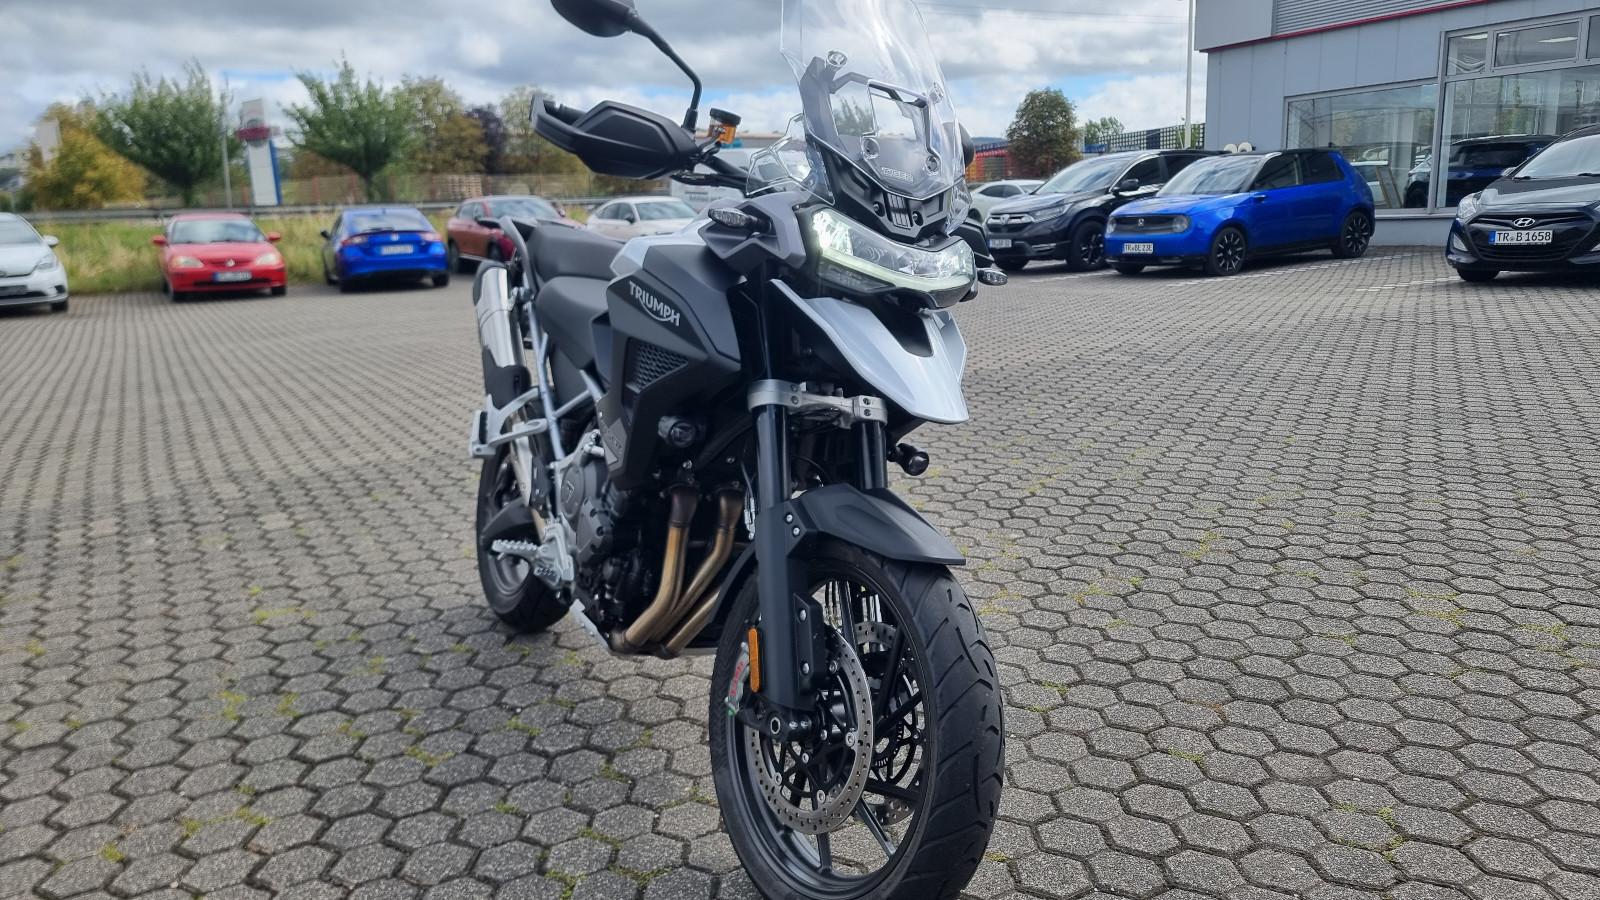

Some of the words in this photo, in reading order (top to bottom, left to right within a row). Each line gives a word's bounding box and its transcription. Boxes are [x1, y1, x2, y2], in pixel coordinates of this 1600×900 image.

[1497, 232, 1510, 242] TR
[1516, 232, 1523, 242] B
[1525, 231, 1551, 242] 1658
[629, 280, 680, 326] TRIUMPH
